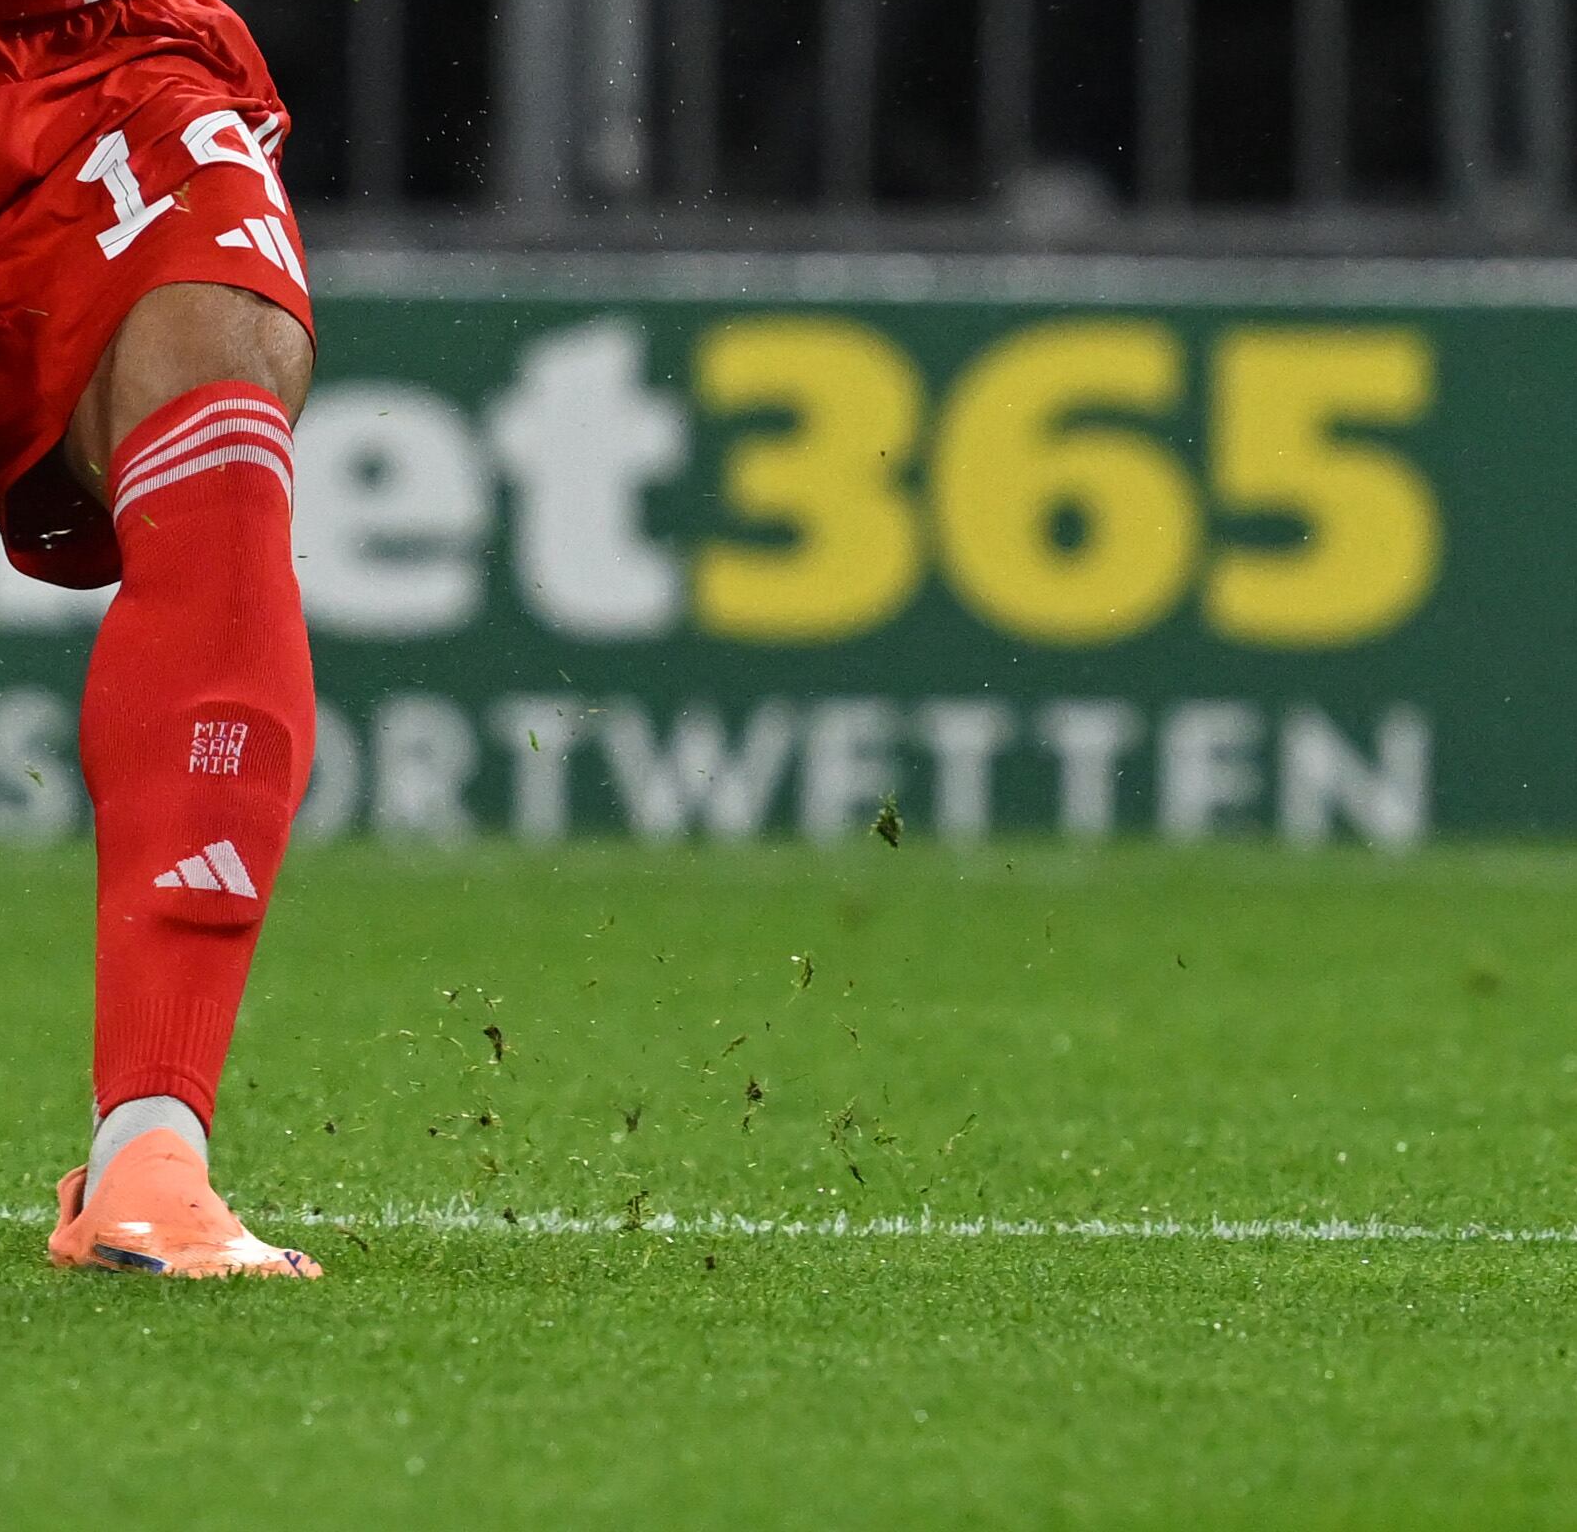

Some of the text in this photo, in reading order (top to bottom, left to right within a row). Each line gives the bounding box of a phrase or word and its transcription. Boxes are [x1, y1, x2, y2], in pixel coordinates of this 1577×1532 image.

[76, 109, 288, 261] 19
[193, 720, 249, 740] MIA
[190, 737, 245, 758] SAN
[189, 755, 239, 776] MIA
